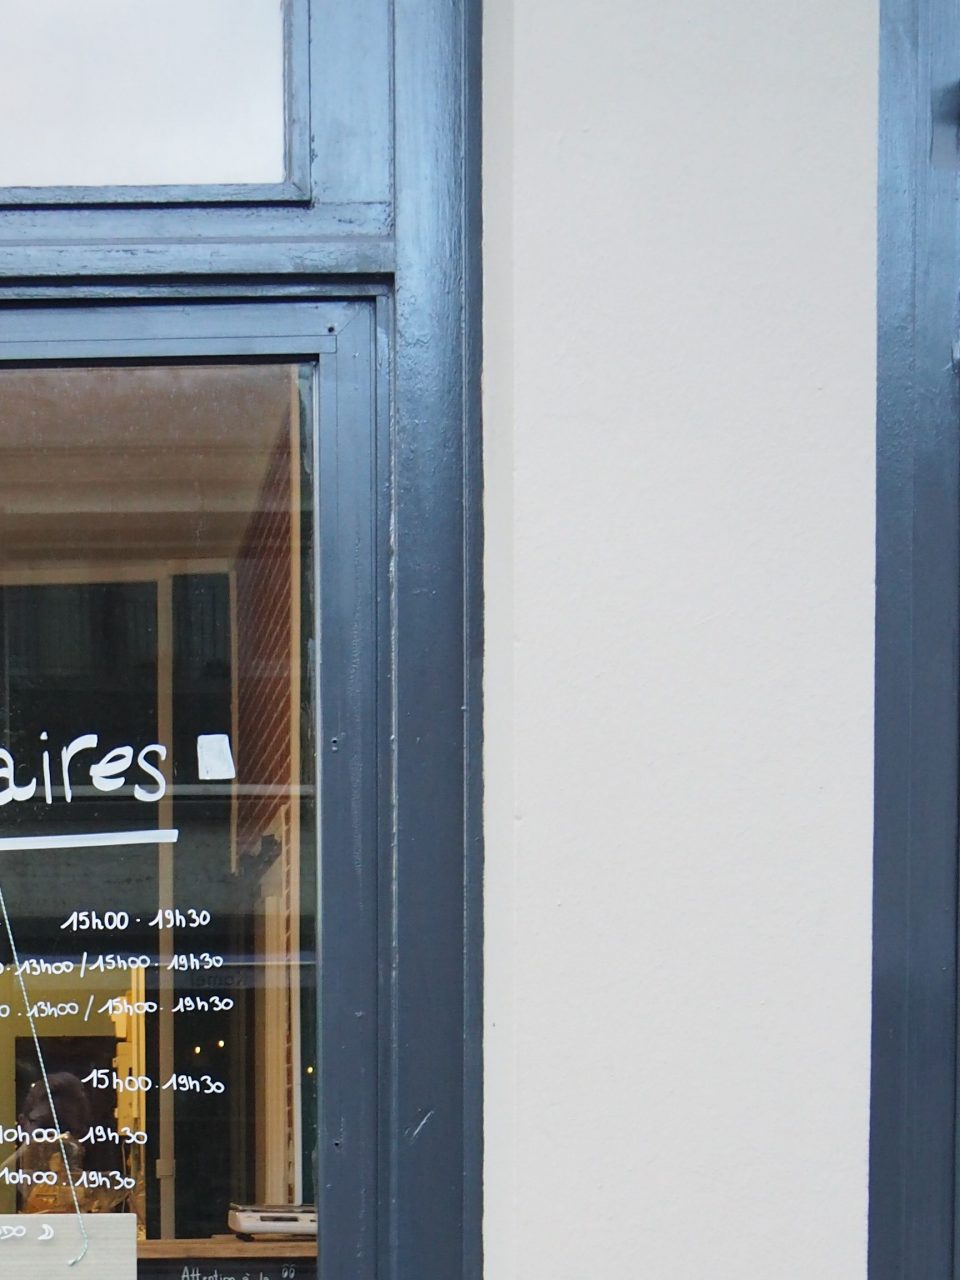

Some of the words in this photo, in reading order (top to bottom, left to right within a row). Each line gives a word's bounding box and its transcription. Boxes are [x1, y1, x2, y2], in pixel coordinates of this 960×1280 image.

[60, 910, 130, 932] 15h00
[148, 908, 211, 929] 19h30
[15, 958, 74, 976] 13h00
[89, 954, 151, 973] 15h00
[167, 952, 224, 971] 19h30
[26, 1001, 79, 1018] 13h00
[97, 997, 158, 1017] 15h00
[171, 996, 234, 1013] 19h30
[81, 1068, 153, 1093] 15h00
[161, 1073, 226, 1094] 19h30
[78, 1125, 148, 1145] 19h30
[75, 1170, 136, 1190] 19h30
